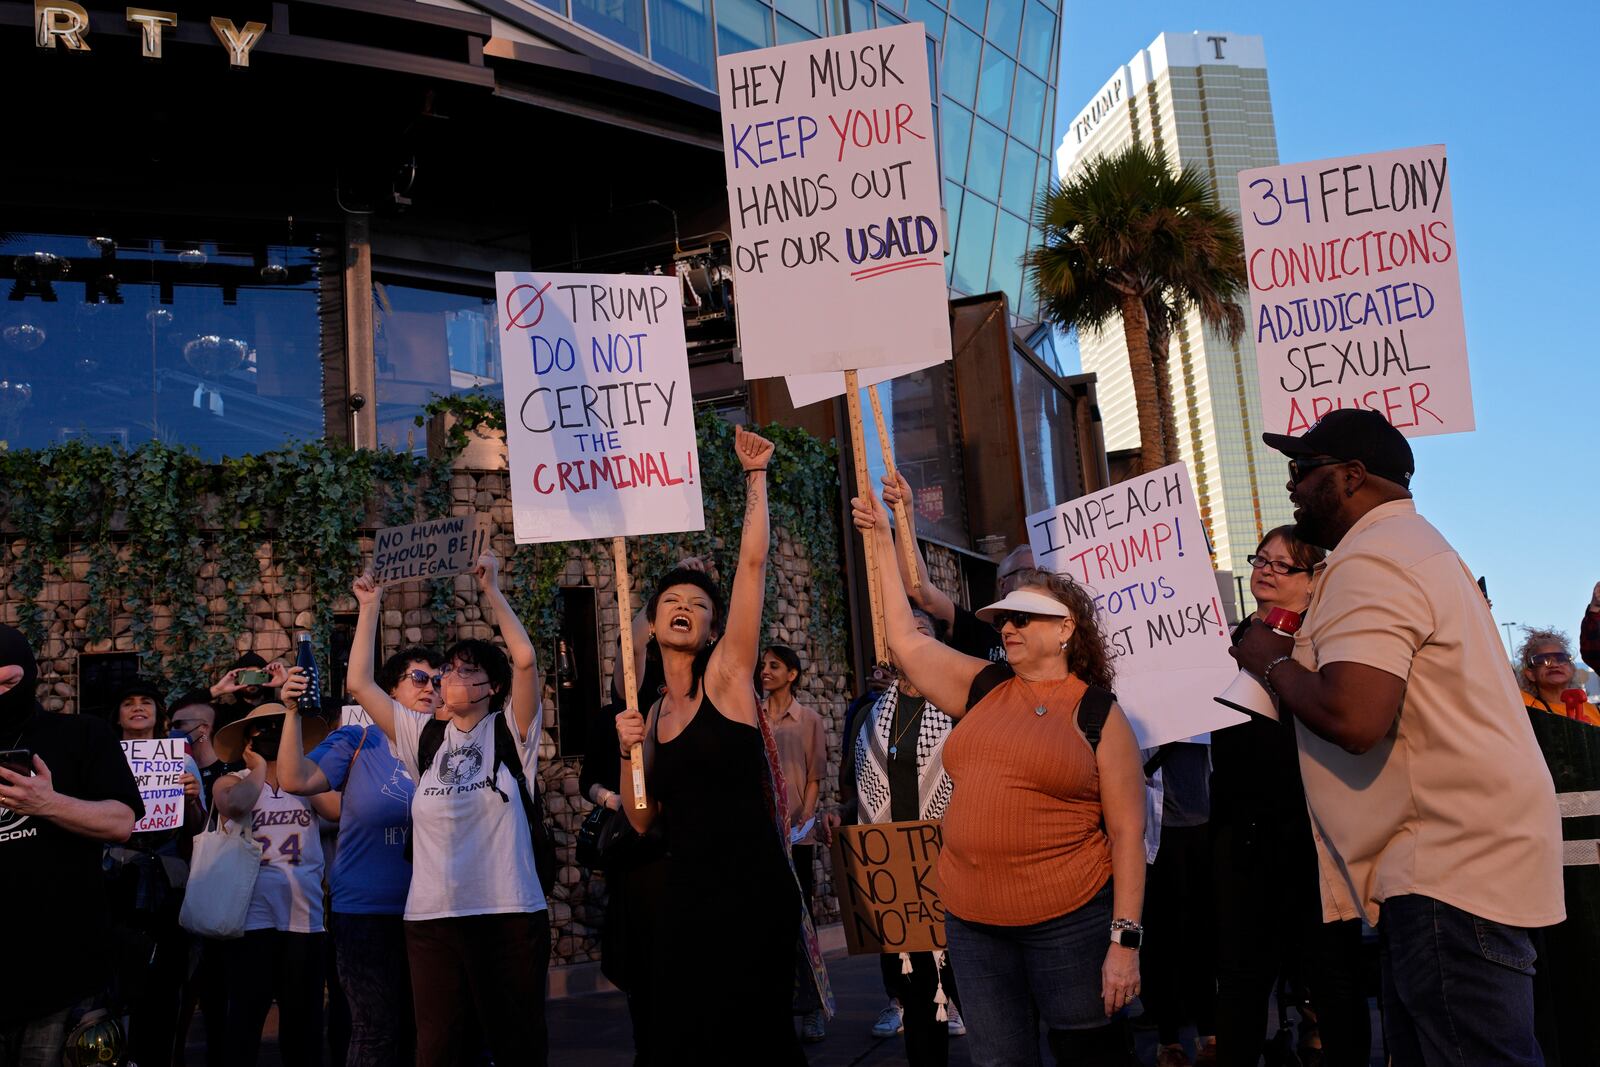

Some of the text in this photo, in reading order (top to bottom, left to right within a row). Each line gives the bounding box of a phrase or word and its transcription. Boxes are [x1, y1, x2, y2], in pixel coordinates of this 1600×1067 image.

[1207, 36, 1228, 60] T
[730, 43, 905, 110] HEY MUSK
[1073, 79, 1122, 144] TRUMP
[730, 103, 927, 169] KEEP YOUR
[737, 160, 912, 229] HANDS OUT
[1249, 157, 1447, 226] 34 FELONY
[736, 215, 938, 273] OF OUR USAID
[1249, 221, 1452, 291] CONVICTIONS
[557, 284, 668, 325] TRUMP
[1257, 282, 1435, 343] ADJUDICATED
[530, 333, 648, 376] DO NOT
[1280, 329, 1431, 392] SEXUAL
[520, 380, 676, 433] CERTIFY
[573, 430, 622, 452] THE
[532, 451, 694, 495] CRIMINAL!
[1033, 472, 1183, 556] IMPEACH
[375, 536, 468, 570] SHOULD BE
[378, 520, 464, 552] NO HUMAN
[1069, 516, 1185, 584] TRUMP!
[1146, 596, 1224, 649] MUSK!
[132, 761, 184, 773] TRIOTS
[156, 774, 180, 786] THE
[139, 788, 184, 800] ITUTION
[153, 803, 177, 815] AN
[424, 786, 454, 796] STAY
[131, 815, 179, 831] IGARCH
[384, 826, 409, 845] HEY
[838, 829, 890, 868] NO
[846, 865, 939, 906] NO K
[853, 899, 945, 948] NO FAS
[929, 924, 948, 949] U
